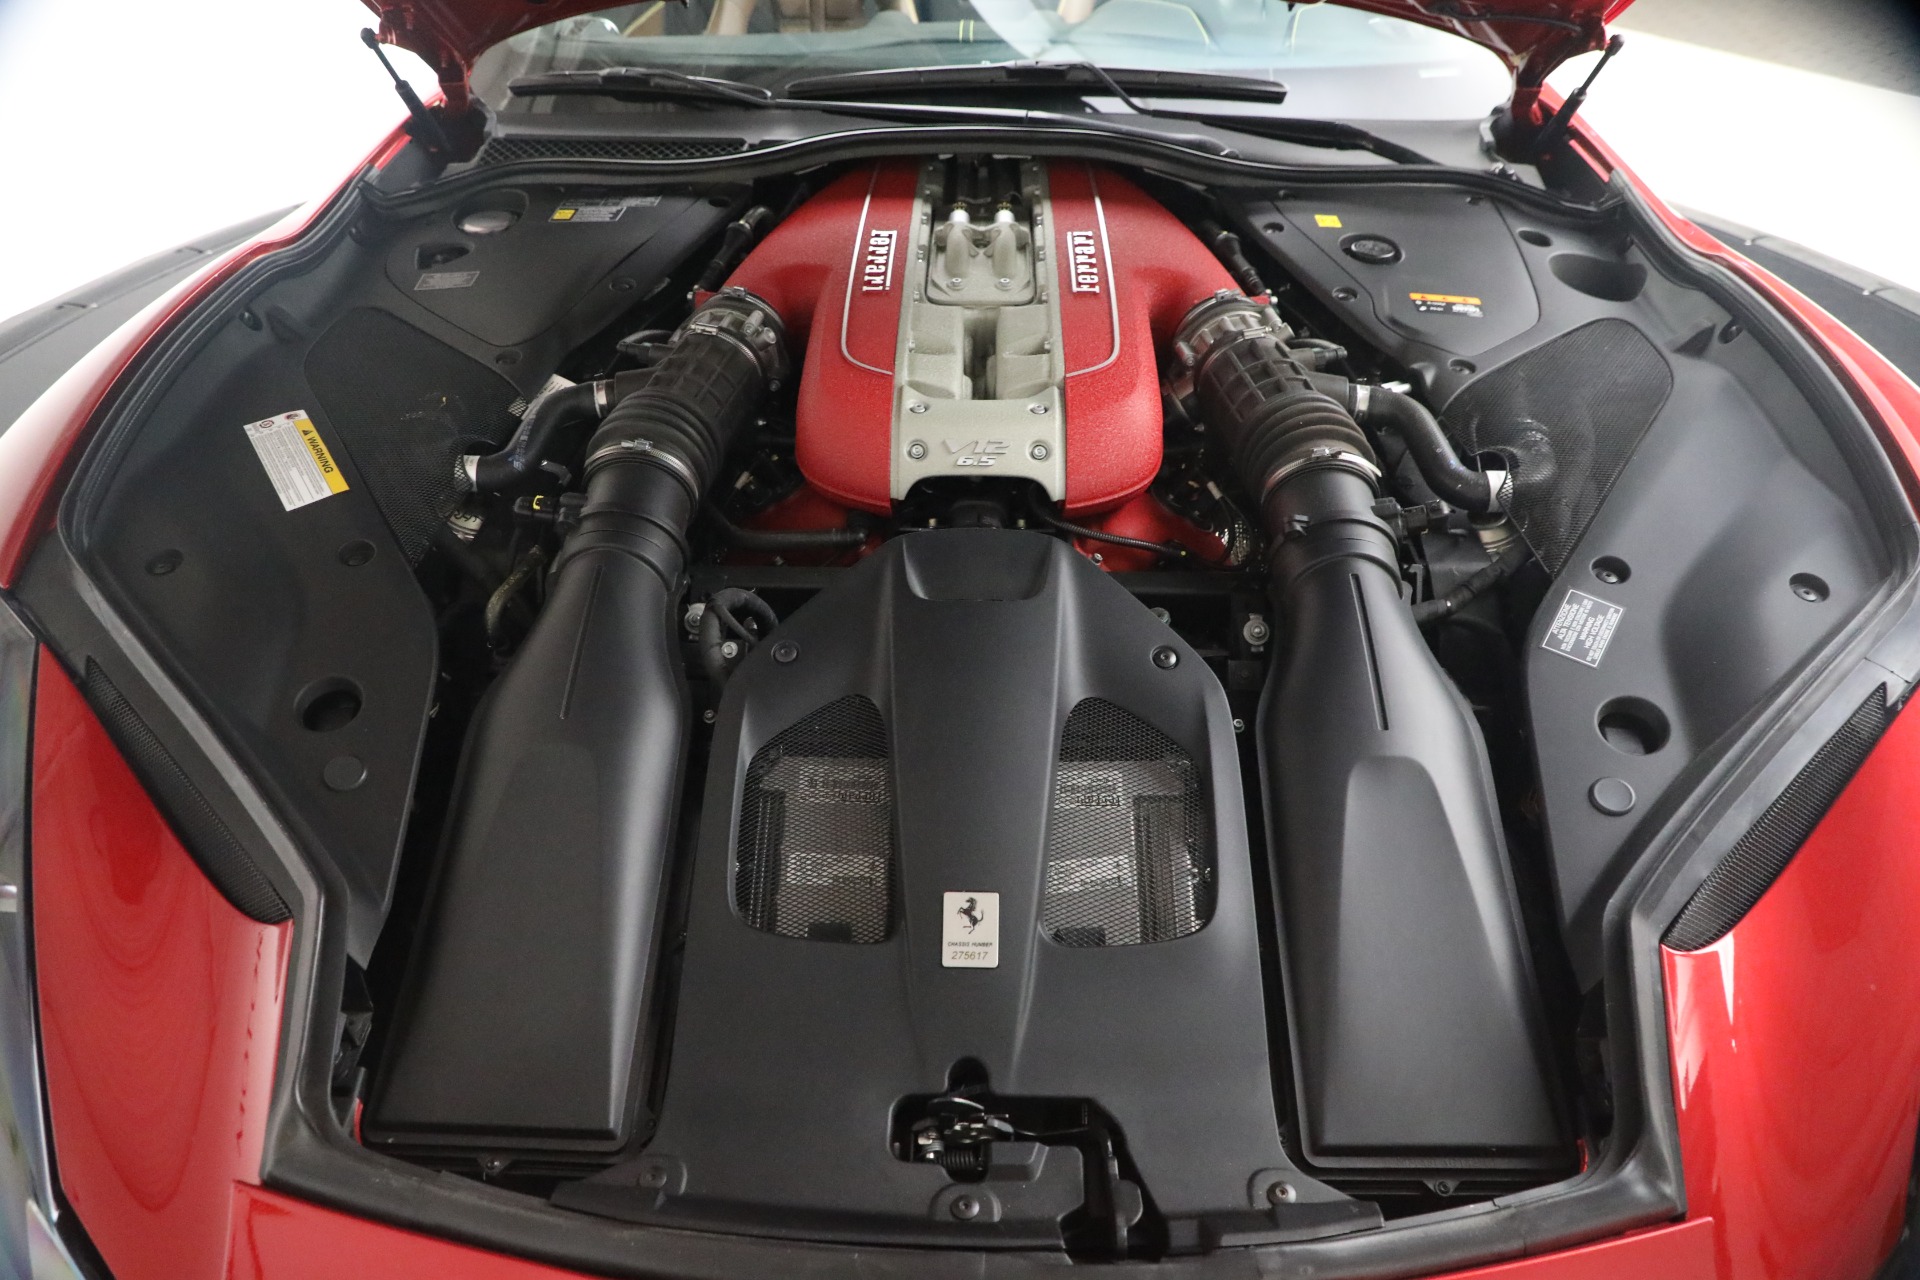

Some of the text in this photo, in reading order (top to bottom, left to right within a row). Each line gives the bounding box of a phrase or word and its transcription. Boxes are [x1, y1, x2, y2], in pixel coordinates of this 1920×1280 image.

[862, 230, 897, 291] Ferrari
[1066, 231, 1100, 293] Ferrari
[307, 436, 334, 474] WARNING
[942, 440, 1011, 455] V12
[956, 455, 997, 467] 6.5
[1578, 617, 1595, 640] WARNING
[951, 951, 989, 960] 275617
